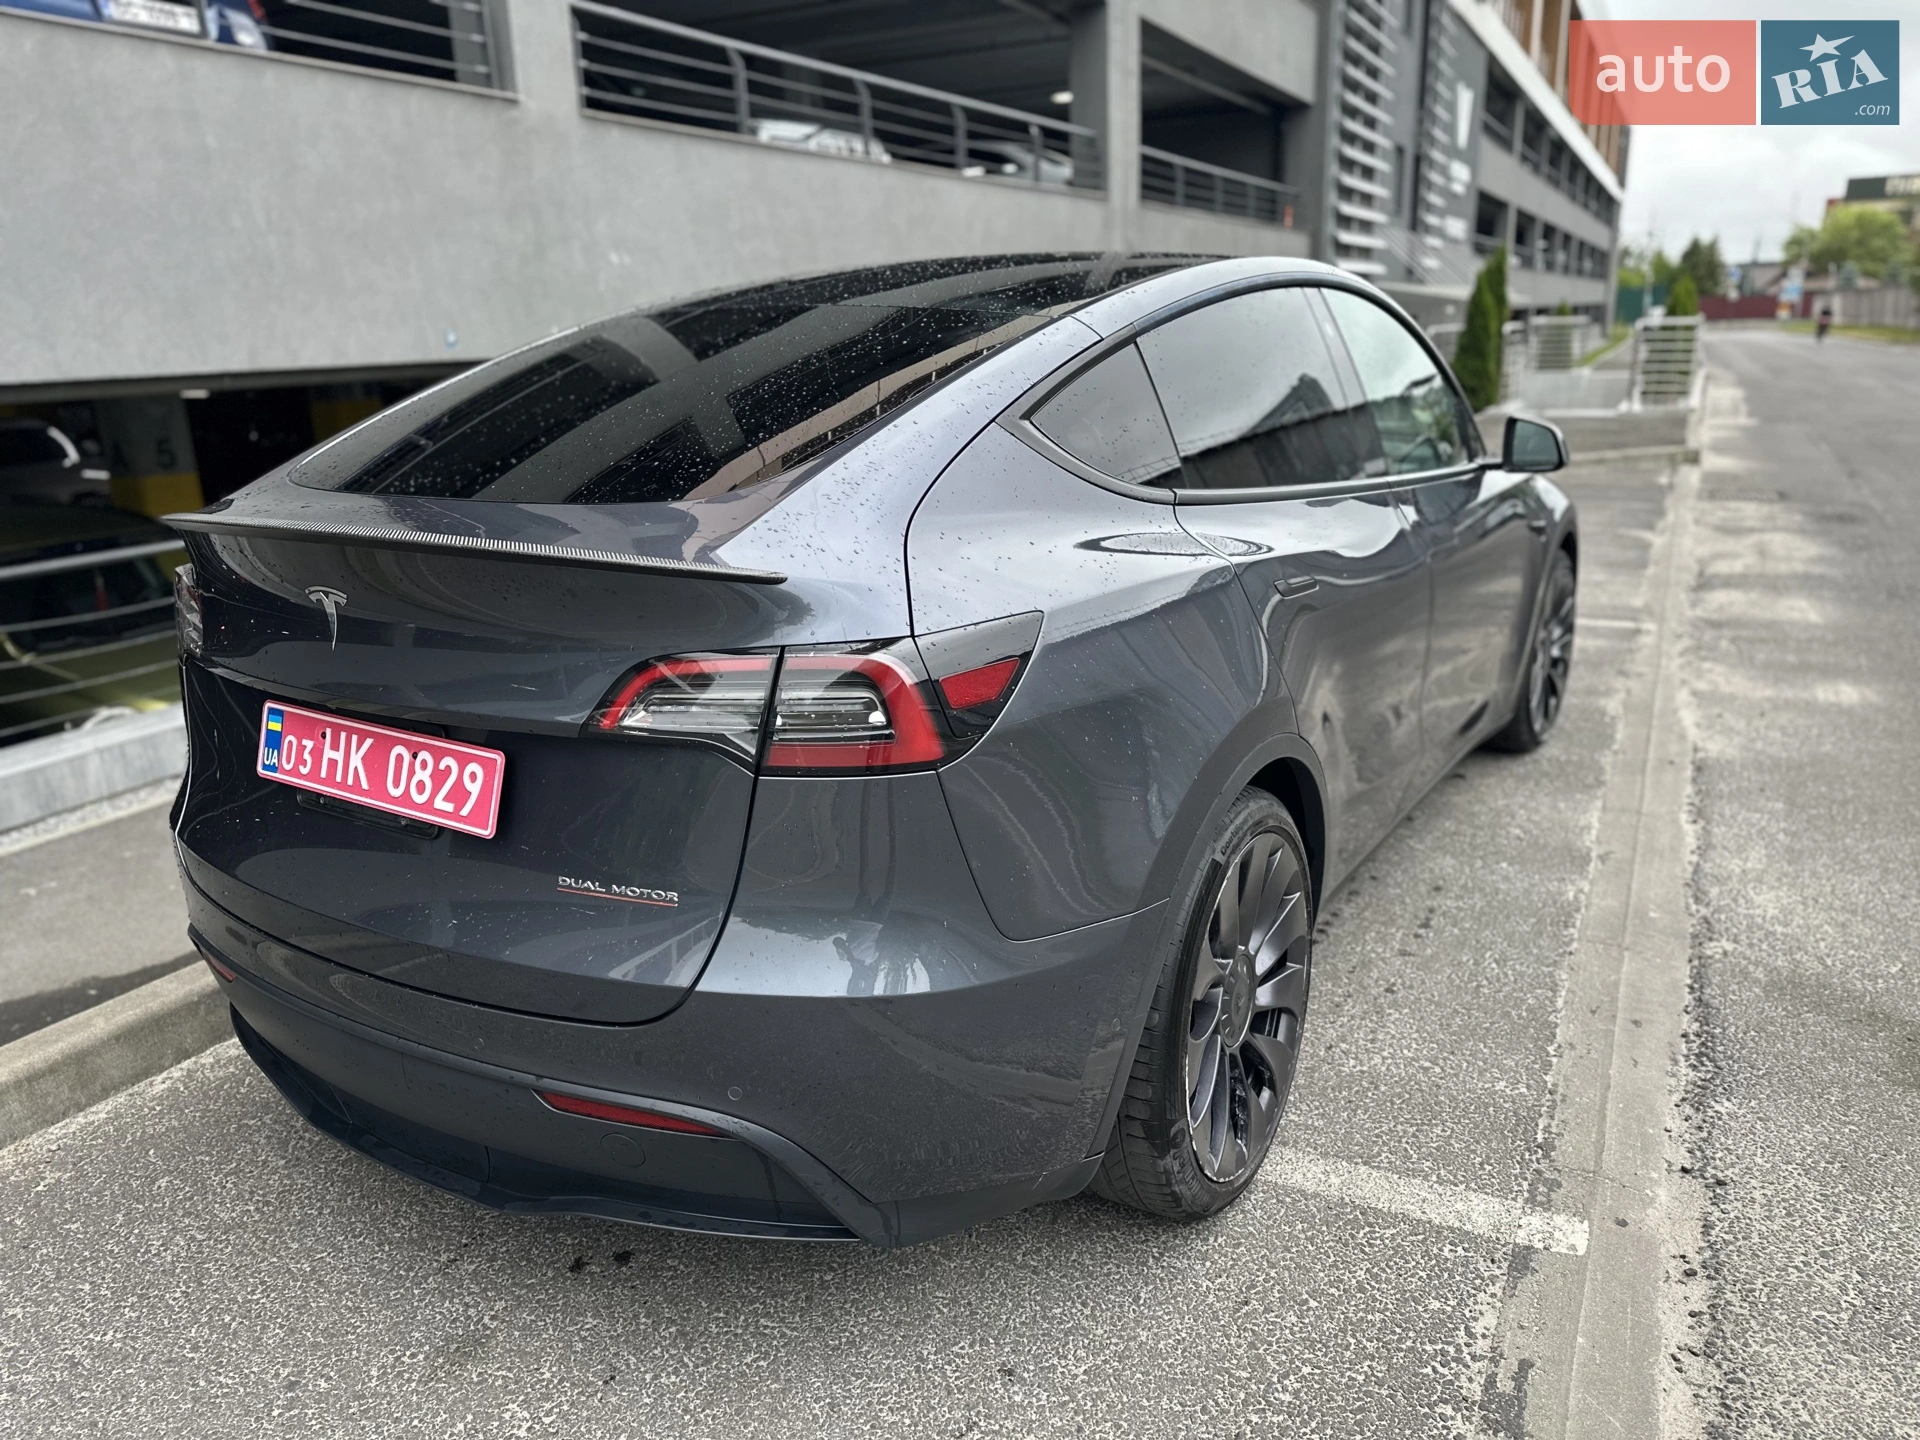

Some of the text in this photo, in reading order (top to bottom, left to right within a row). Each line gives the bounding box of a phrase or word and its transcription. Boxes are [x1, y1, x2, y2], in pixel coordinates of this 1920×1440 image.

[263, 746, 279, 768] UA
[281, 727, 485, 818] 03 HK 0829
[558, 875, 679, 902] DUAL MOTOR
